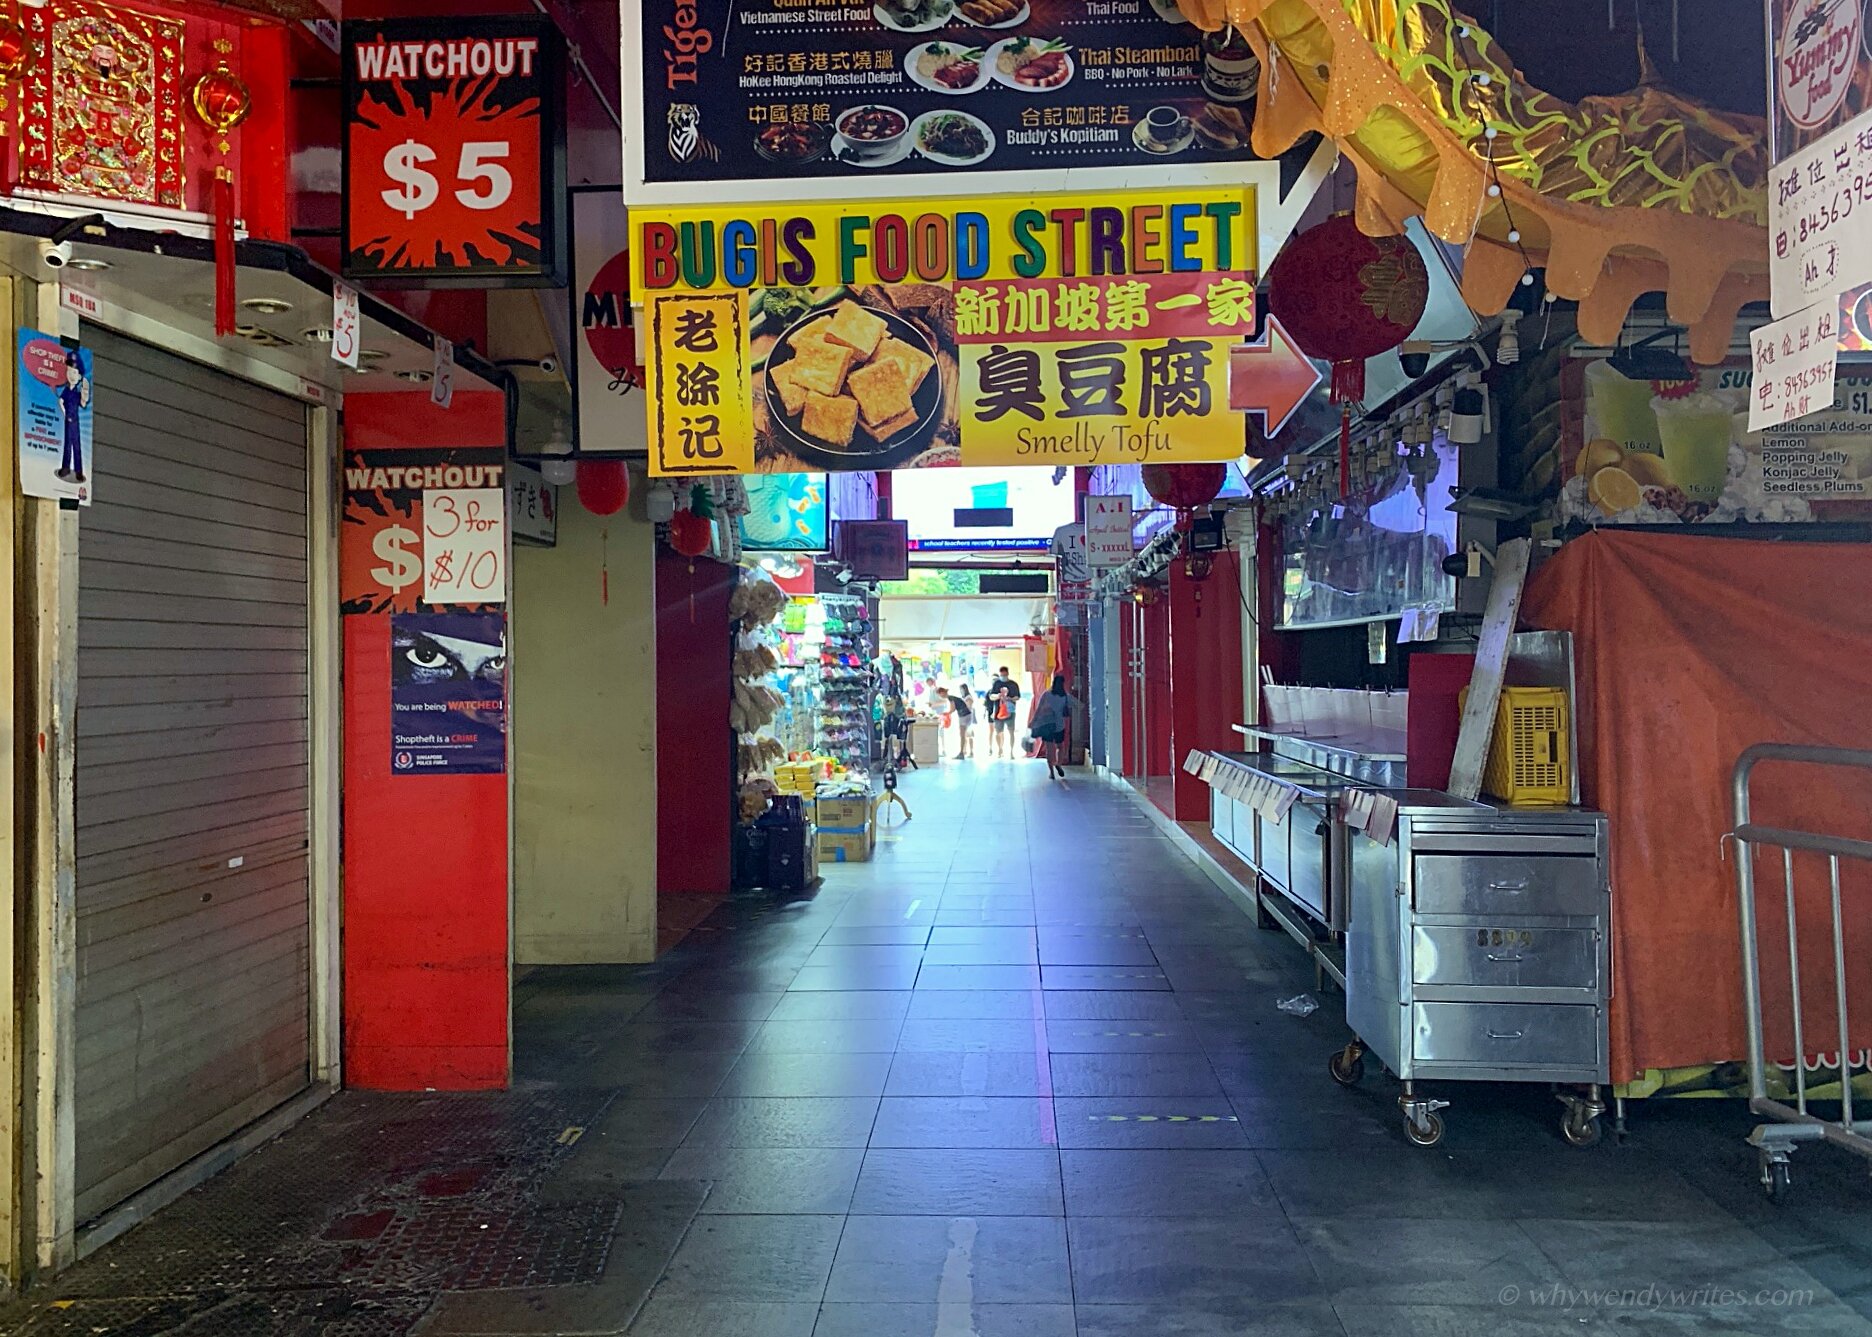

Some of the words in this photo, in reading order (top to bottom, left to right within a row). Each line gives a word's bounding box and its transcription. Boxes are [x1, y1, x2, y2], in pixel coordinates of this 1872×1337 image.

[740, 11, 805, 24] Vietnamese
[807, 9, 842, 22] Street
[844, 8, 871, 21] Food
[1087, 2, 1110, 15] Thai
[1112, 1, 1139, 14] Food
[356, 39, 538, 80] WATCHOUT
[1079, 48, 1112, 65] Thai
[1114, 45, 1200, 64] Steamboat
[1784, 18, 1857, 88] Yummy
[773, 73, 823, 89] HongKong
[825, 72, 866, 85] Roasted
[867, 71, 902, 86] Delight
[1084, 69, 1104, 80] BBQ
[1111, 68, 1124, 79] No
[1126, 67, 1149, 79] Pork
[1156, 66, 1169, 77] No
[748, 103, 831, 124] 中國餐館
[1006, 128, 1058, 146] Buddy's
[1060, 127, 1119, 144] Kopitiam
[643, 217, 816, 289] BUGIS
[840, 212, 991, 284] FOOD
[1013, 202, 1242, 279] STREET
[953, 277, 1253, 335] 新加坡第一家
[674, 309, 724, 459] 老涂记
[974, 338, 1213, 422] 臭豆腐
[1016, 421, 1105, 462] Smelly
[1111, 420, 1171, 462] Tofu
[1762, 438, 1805, 447] Lemon
[1762, 453, 1815, 464] Popping
[1819, 452, 1848, 463] Jelly
[346, 466, 503, 490] WATCHOUT
[1763, 467, 1807, 478] Konjac
[1811, 467, 1840, 478] Jelly
[1763, 482, 1820, 492] Seedless
[1825, 482, 1863, 491] Plums
[427, 496, 460, 538] 3
[465, 500, 499, 532] for
[371, 524, 423, 594] $
[430, 550, 498, 590] $10
[395, 703, 410, 711] You
[425, 703, 447, 713] being
[448, 701, 503, 710] WATCHED!
[395, 735, 435, 744] Shoptheft
[437, 735, 444, 743] is
